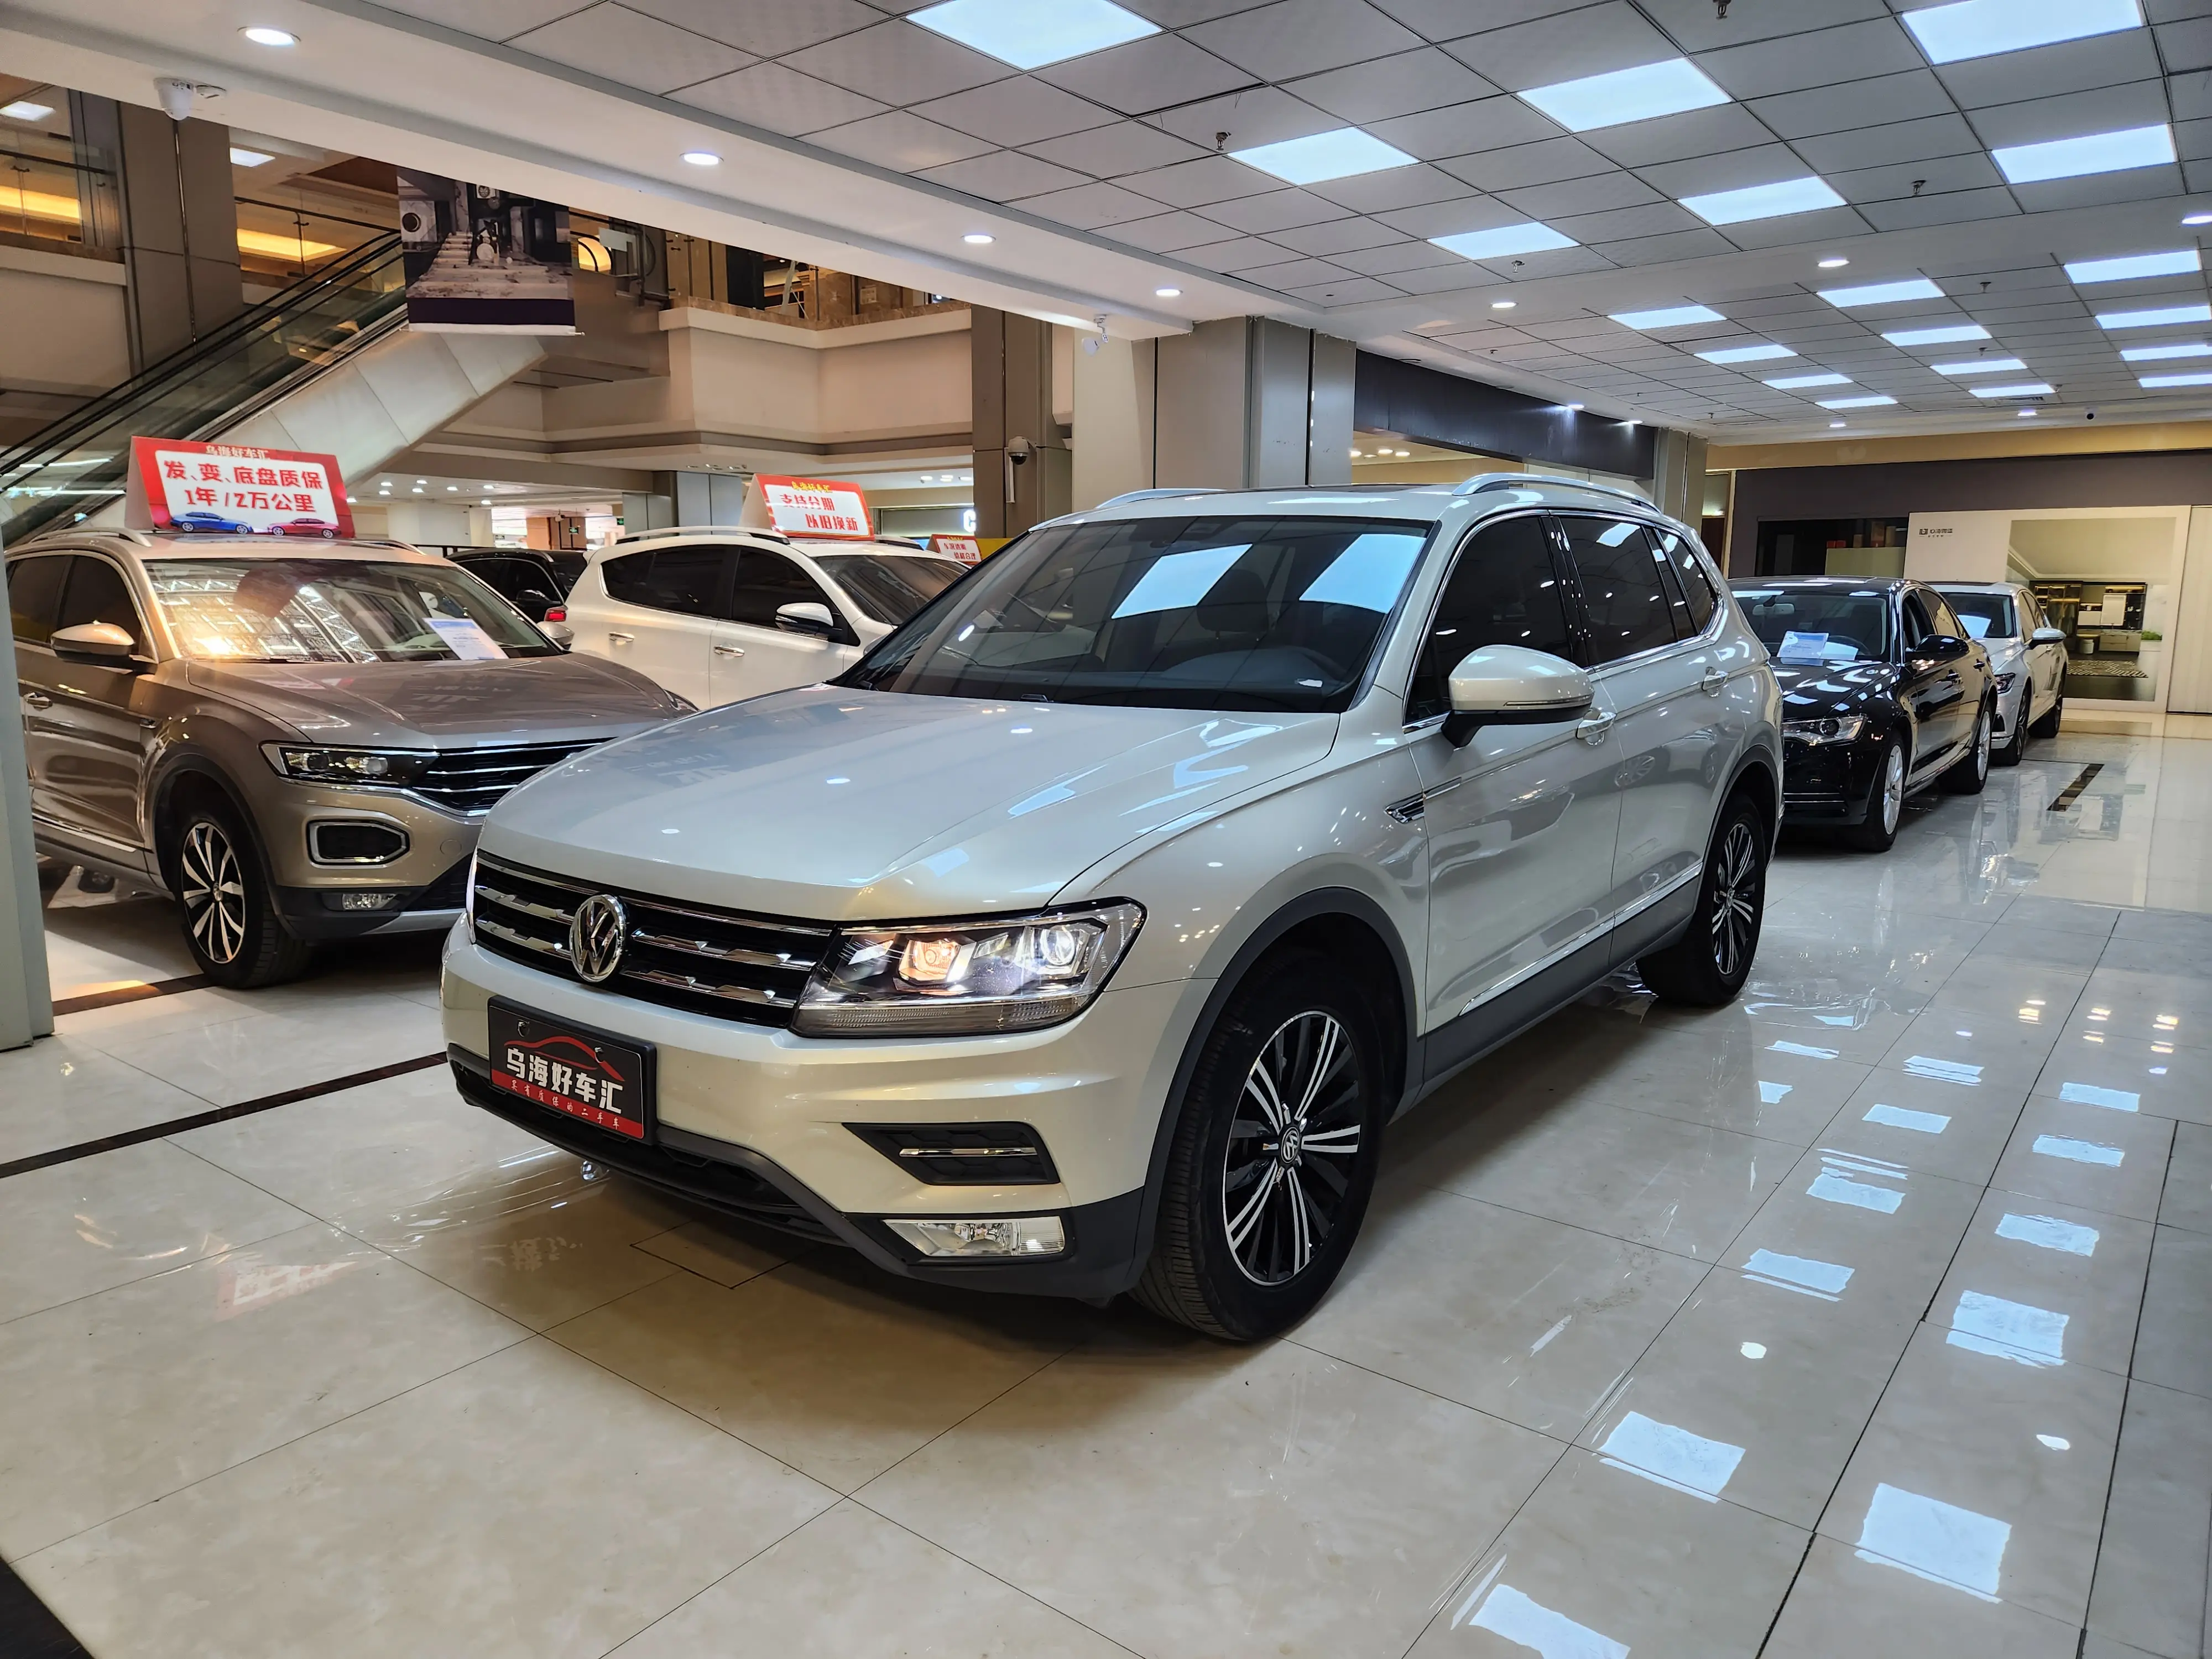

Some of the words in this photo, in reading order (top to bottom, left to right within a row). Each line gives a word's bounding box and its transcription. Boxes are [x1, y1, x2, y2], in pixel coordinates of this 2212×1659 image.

[205, 445, 270, 460] 乌海好车汇
[164, 460, 323, 489] 发、变、底盘质保
[781, 494, 835, 512] 支持分期
[806, 513, 858, 531] 以旧换新
[507, 1047, 623, 1114] 乌海好车汇
[511, 1079, 619, 1130] 买有质保的二手车
